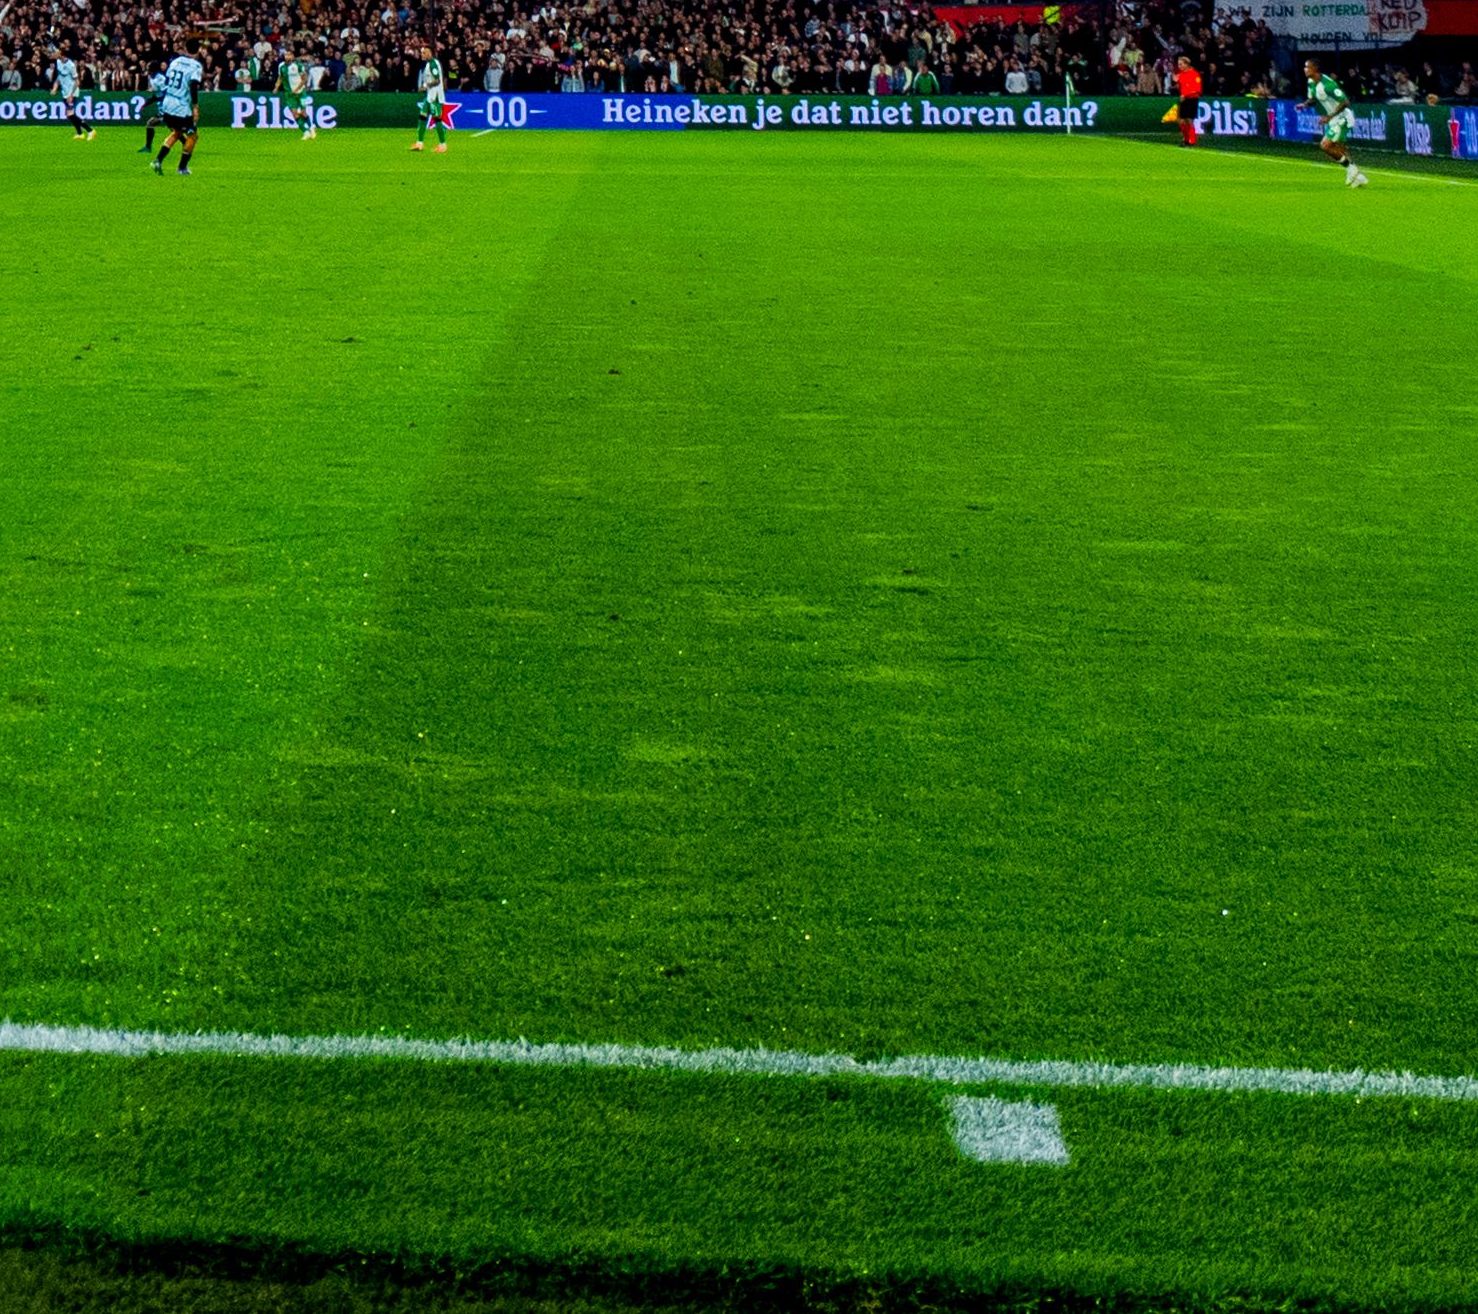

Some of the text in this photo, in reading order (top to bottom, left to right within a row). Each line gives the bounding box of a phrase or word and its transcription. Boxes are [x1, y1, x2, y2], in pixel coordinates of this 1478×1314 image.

[1262, 6, 1294, 17] ZIJN
[1302, 4, 1369, 16] ROTTERDA
[76, 96, 145, 121] dan?
[602, 98, 1098, 130] Heineken je dat niet horen dan?
